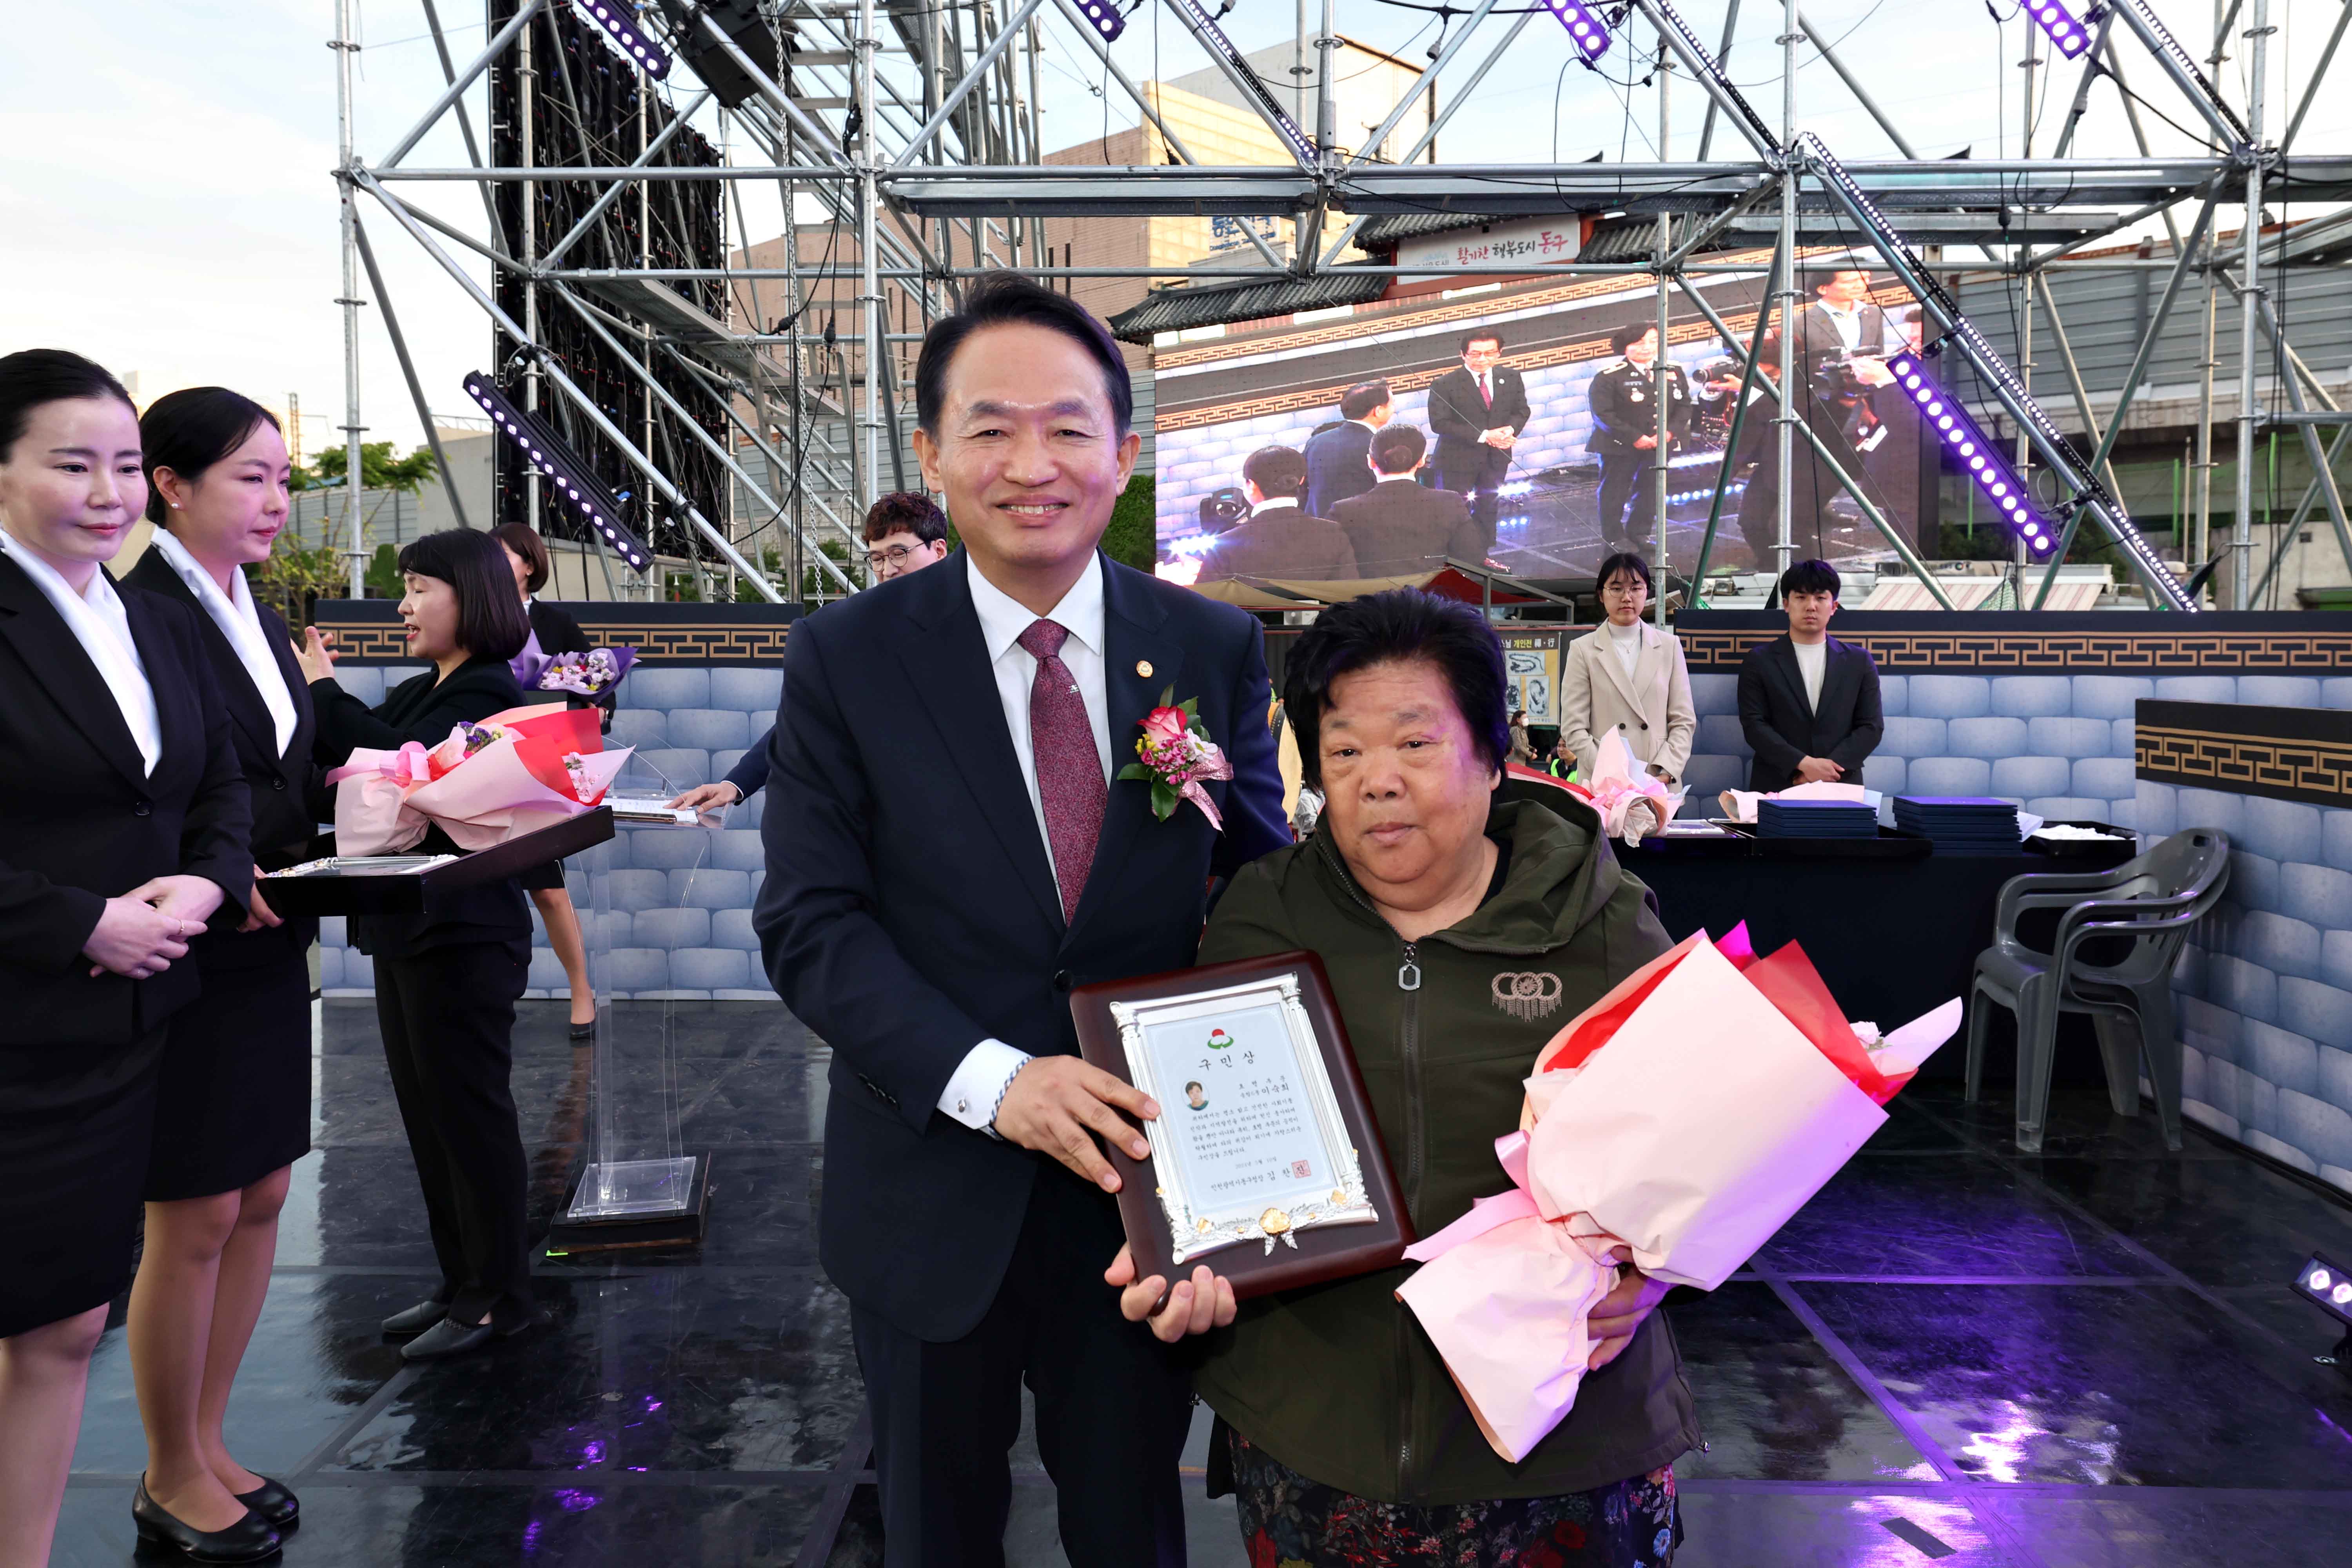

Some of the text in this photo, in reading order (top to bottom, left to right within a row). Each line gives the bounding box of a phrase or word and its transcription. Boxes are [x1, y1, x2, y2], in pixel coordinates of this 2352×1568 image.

[1457, 231, 1568, 265] 활기찬 행복도시 동구
[1514, 639, 1532, 648] 개인전
